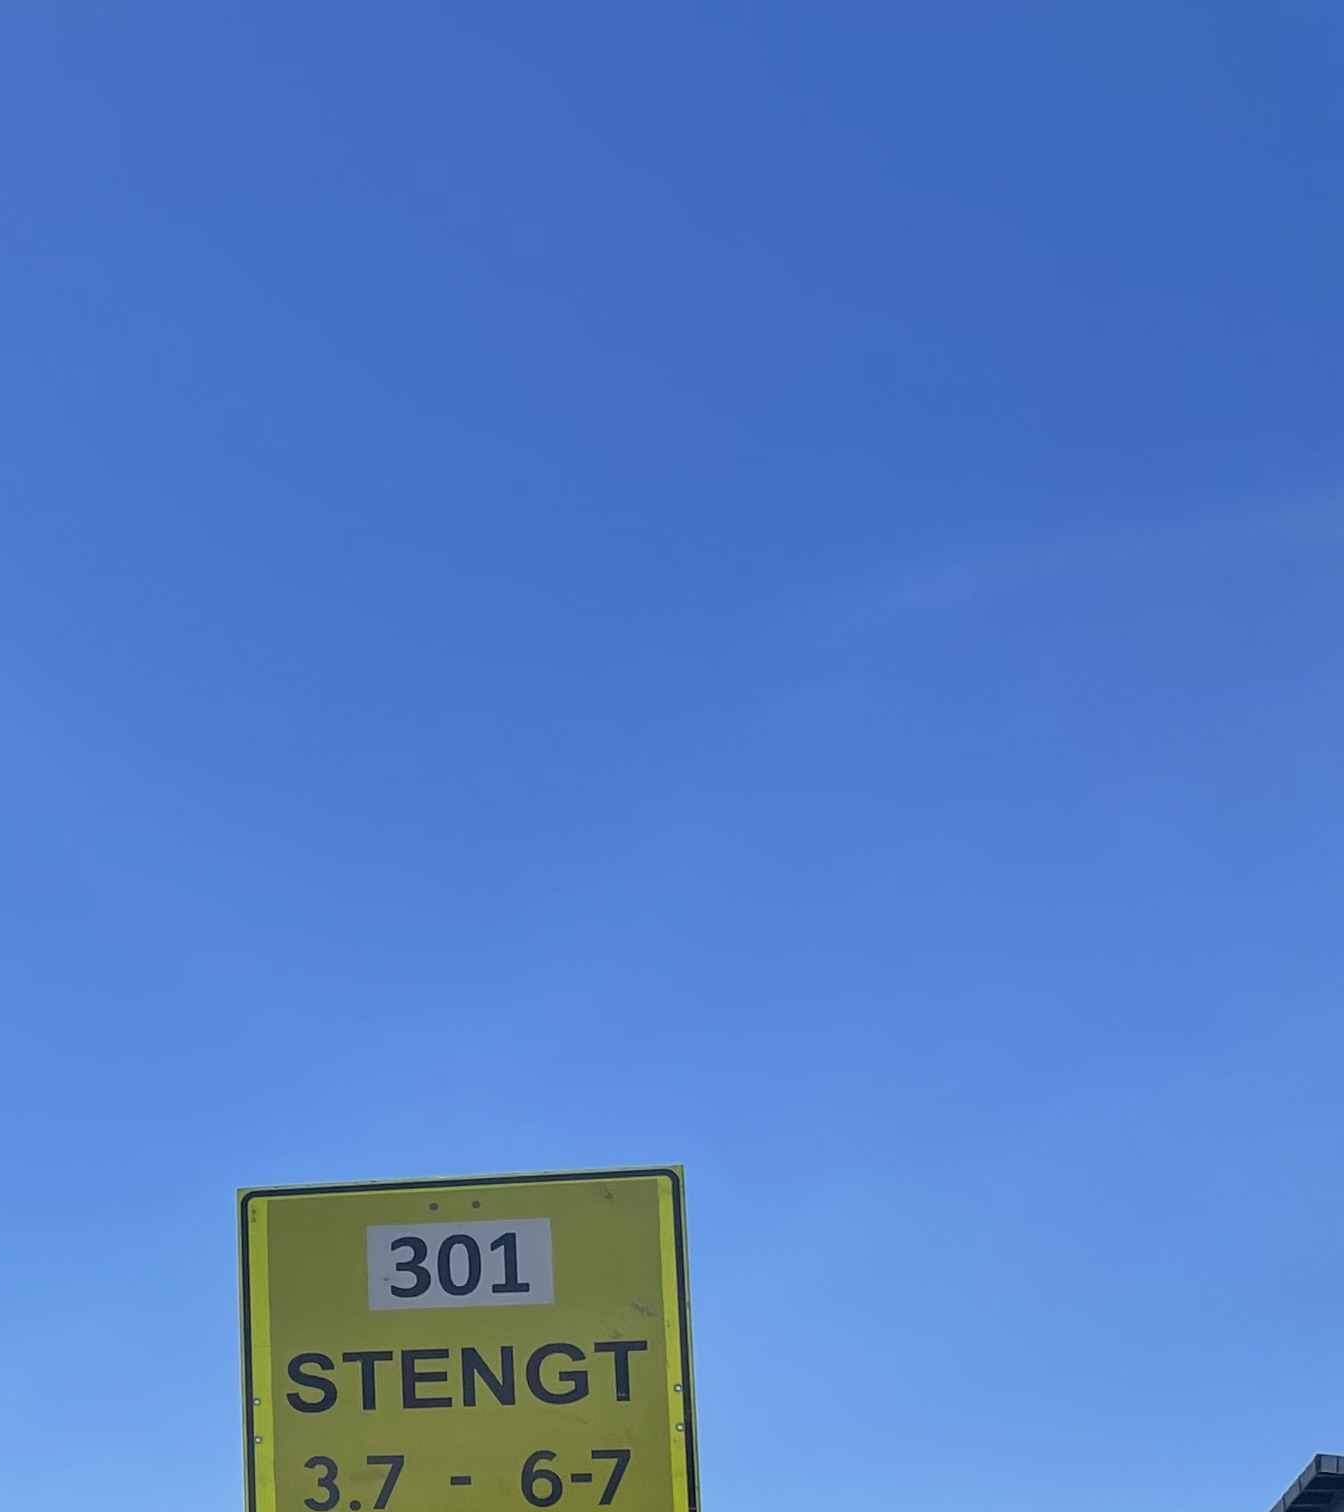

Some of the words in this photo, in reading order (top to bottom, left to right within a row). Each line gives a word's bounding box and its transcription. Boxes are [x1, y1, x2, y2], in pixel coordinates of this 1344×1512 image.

[389, 1232, 530, 1298] 301
[286, 1340, 649, 1413] STENGT
[303, 1454, 405, 1512] 3.7
[520, 1449, 631, 1508] 6-7
